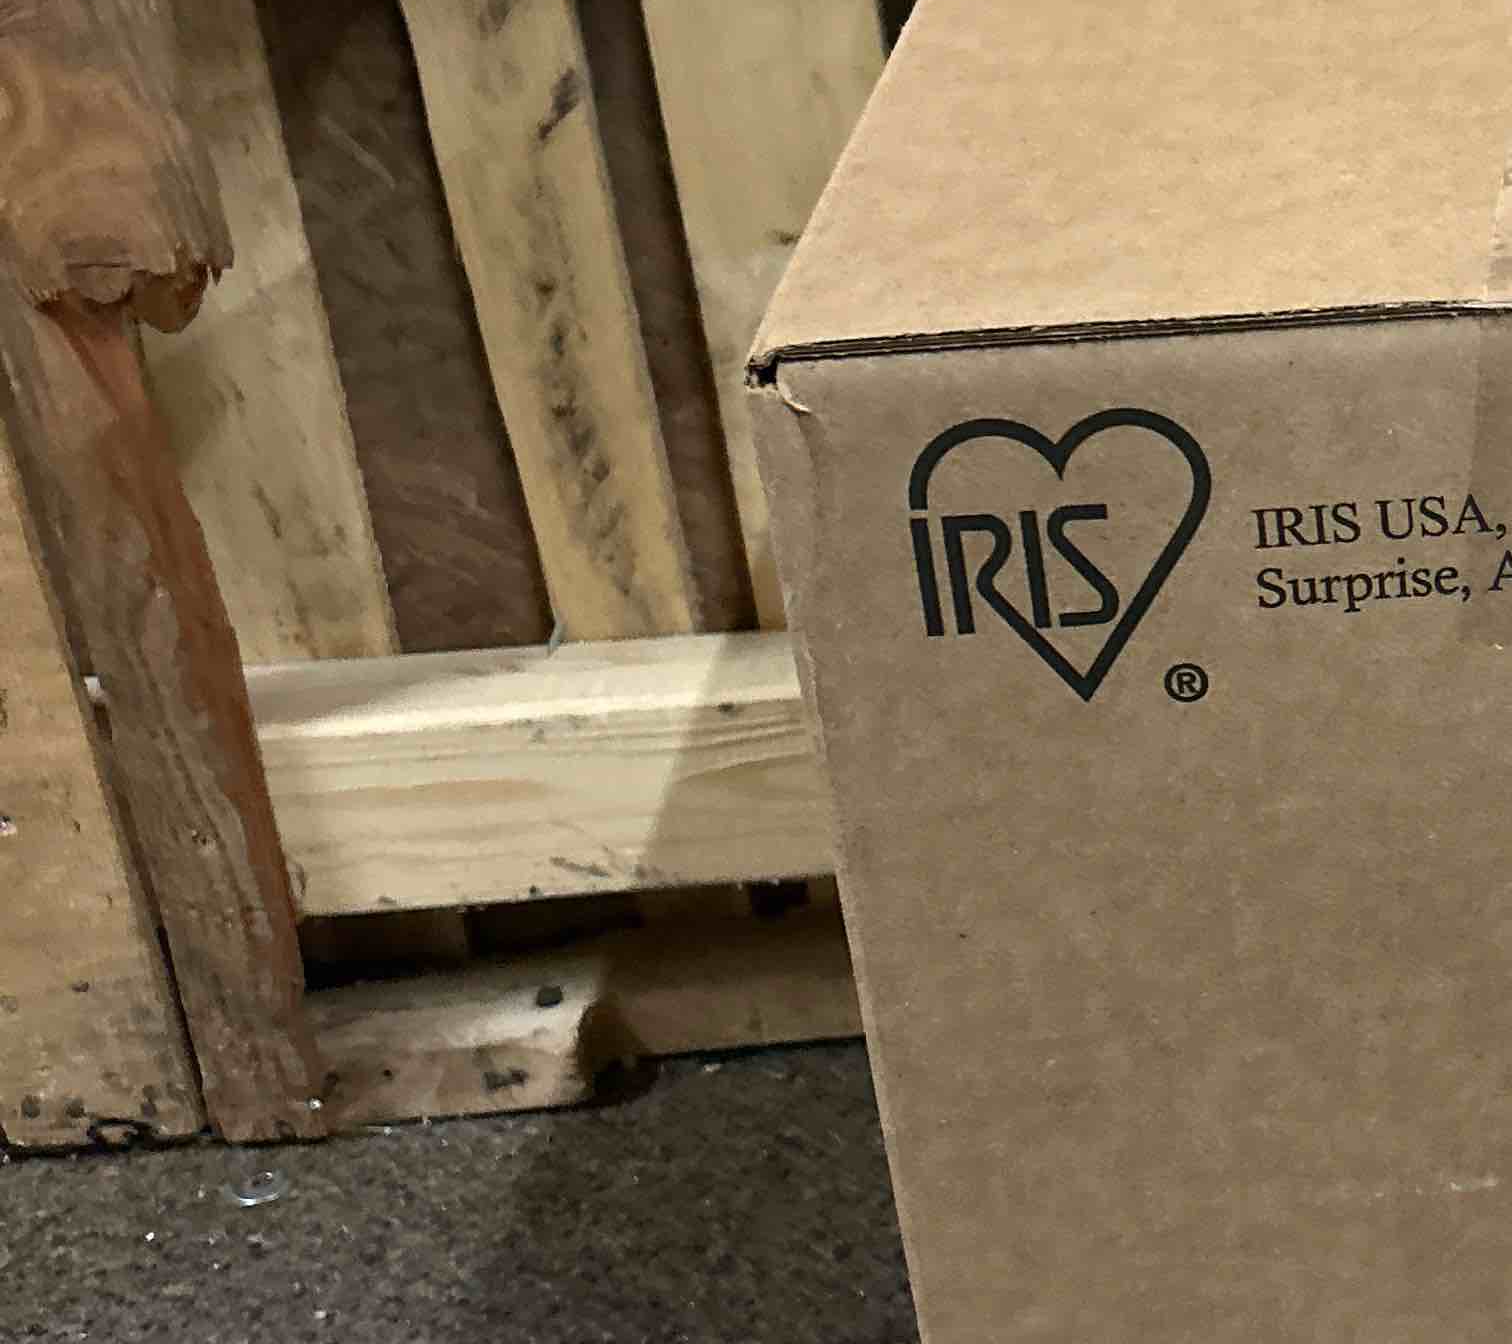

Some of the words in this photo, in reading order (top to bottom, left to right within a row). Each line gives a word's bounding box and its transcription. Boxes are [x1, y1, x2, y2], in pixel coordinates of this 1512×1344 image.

[1251, 502, 1362, 549] IRIS
[1375, 493, 1507, 544] USA,
[909, 503, 1121, 637] IRIS
[1257, 563, 1471, 614] Surprise,
